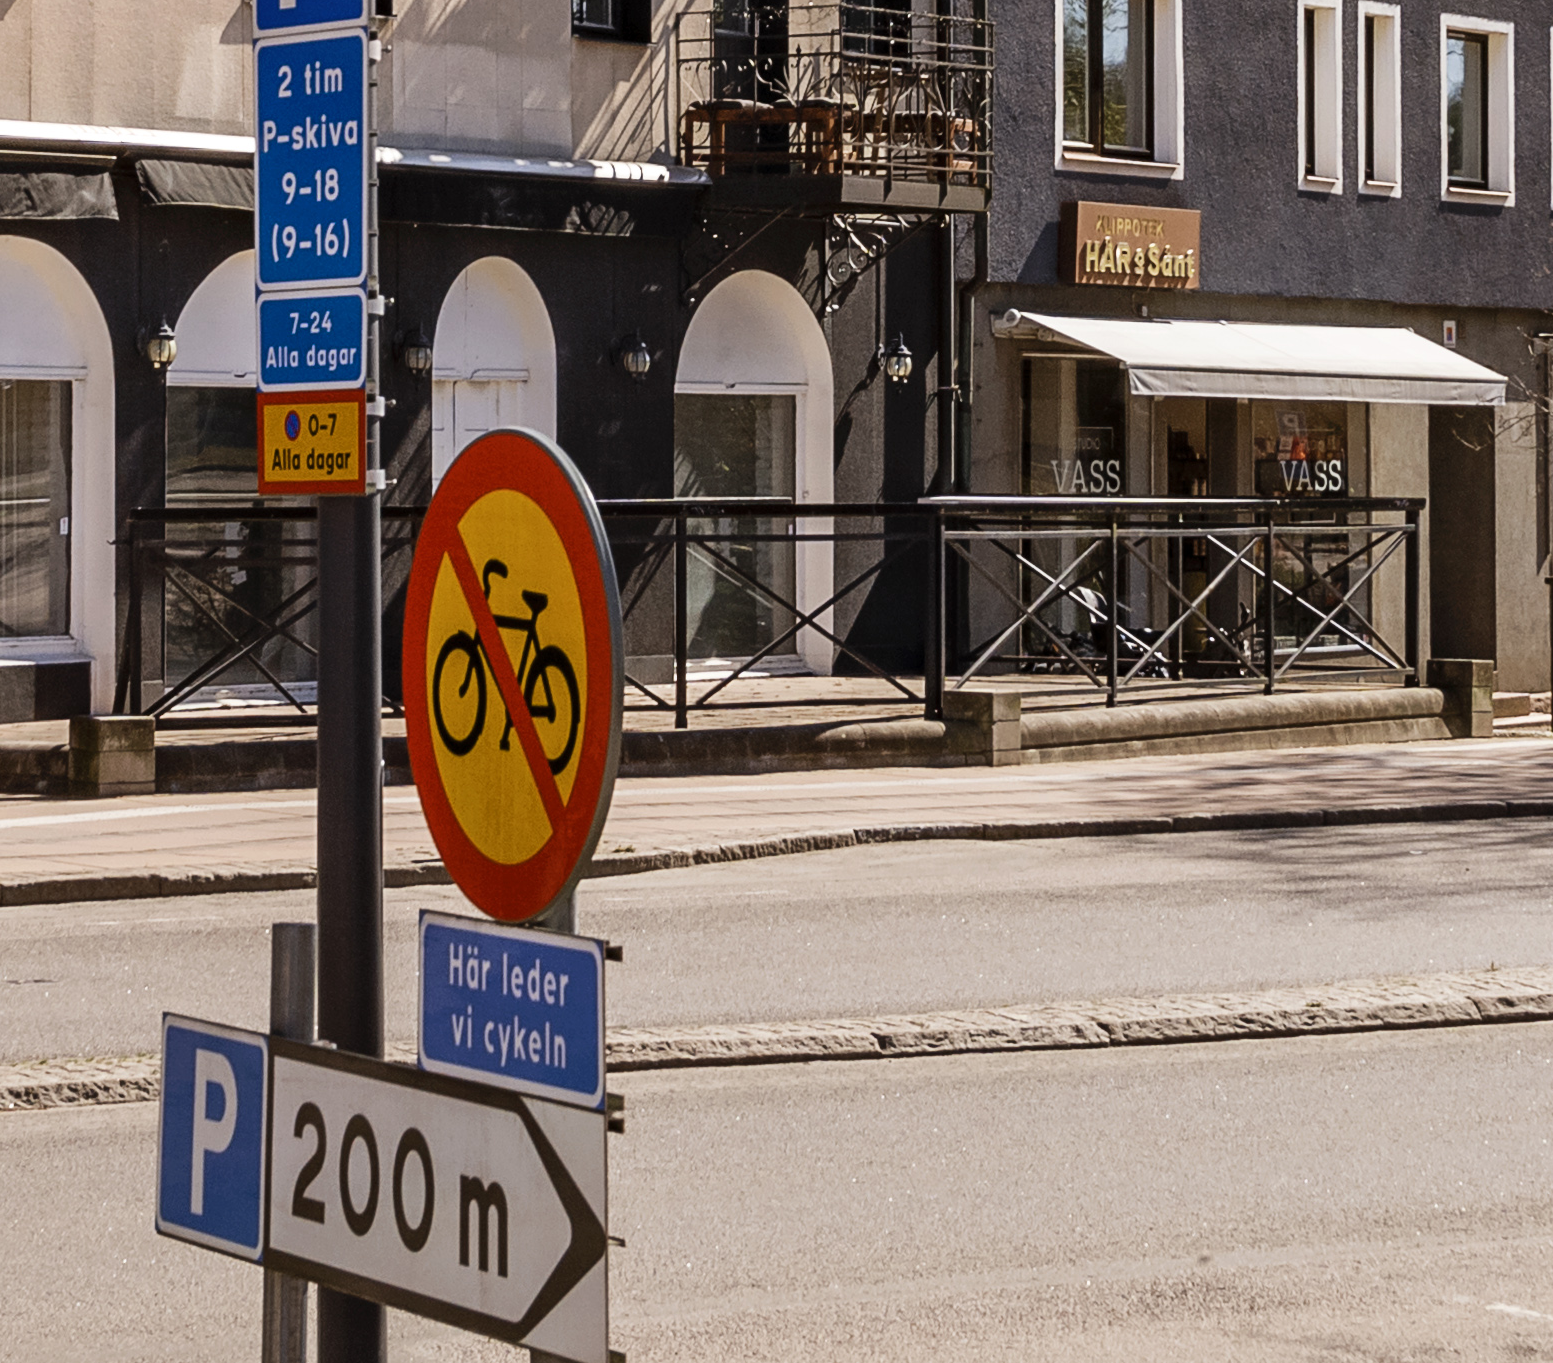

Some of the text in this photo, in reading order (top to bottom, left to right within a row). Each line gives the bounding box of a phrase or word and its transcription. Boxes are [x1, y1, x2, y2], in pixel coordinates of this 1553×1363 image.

[278, 61, 343, 98] 2 tim
[263, 114, 358, 153] P-skiva
[282, 168, 339, 204] 9-18
[272, 218, 349, 263] (9-16)
[1085, 236, 1131, 274] HÅR
[289, 311, 332, 335] 7-24
[266, 344, 358, 371] Alla dagar
[308, 414, 337, 437] 0-7
[272, 447, 351, 475] Alla dagar
[1050, 459, 1121, 493] VASS
[1279, 459, 1342, 491] VASS
[449, 942, 569, 1007] Här leder
[452, 1005, 566, 1069] vi cykeln
[190, 1048, 238, 1216] P
[291, 1101, 509, 1279] 200 m
